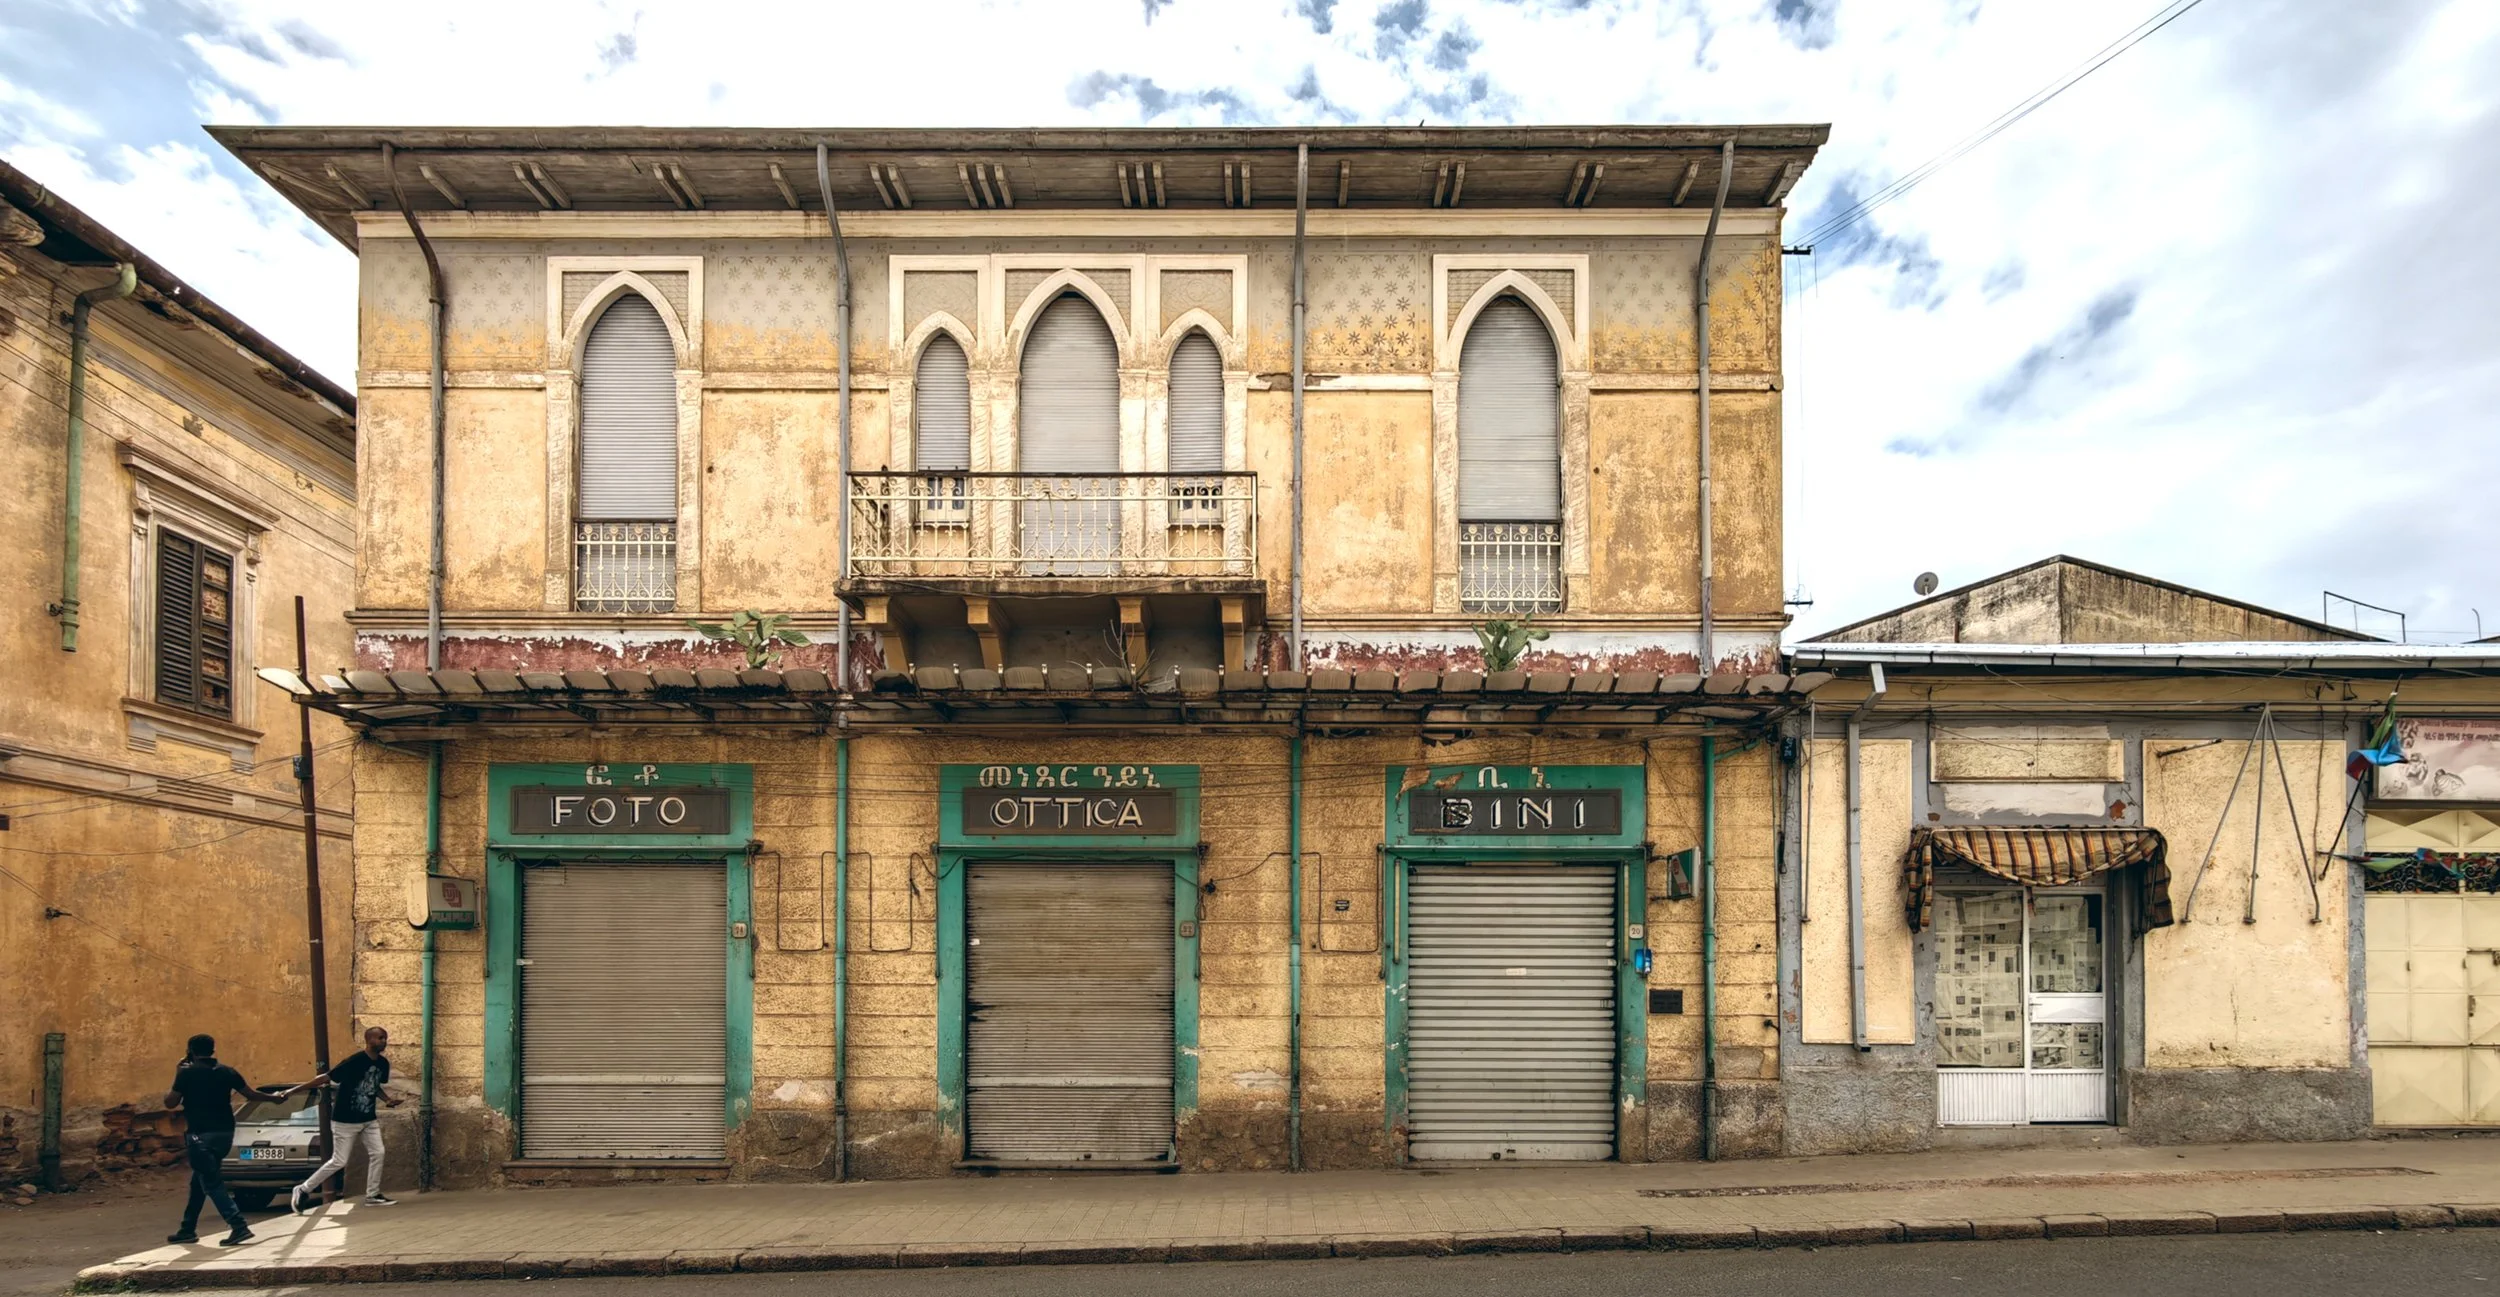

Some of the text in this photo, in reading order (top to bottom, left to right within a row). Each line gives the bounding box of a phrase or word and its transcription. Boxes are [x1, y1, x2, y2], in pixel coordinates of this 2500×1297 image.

[551, 795, 687, 827] FOTO
[990, 796, 1145, 828] OTTICA
[1441, 797, 1586, 829] BINI
[1631, 927, 1641, 935] 20
[253, 1149, 282, 1158] B3988
